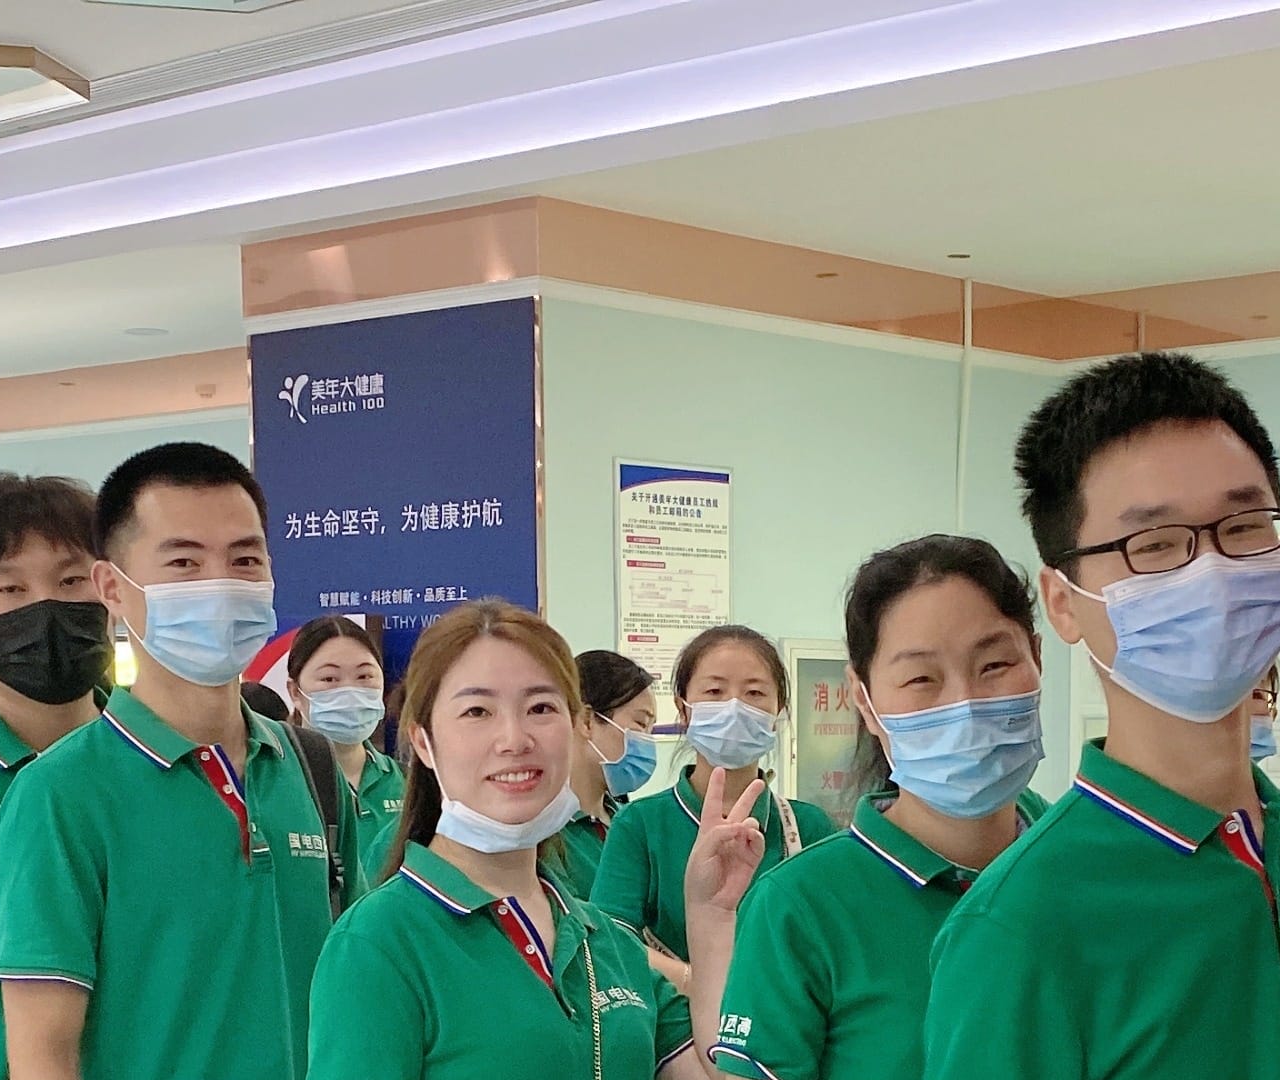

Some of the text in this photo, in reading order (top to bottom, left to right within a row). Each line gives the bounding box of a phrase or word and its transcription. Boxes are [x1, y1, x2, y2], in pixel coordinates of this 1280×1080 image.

[311, 373, 384, 400] 美年大健康
[311, 397, 385, 415] Health 100
[382, 615, 417, 630] LTHY
[288, 832, 326, 850] 国电西
[719, 1014, 752, 1037] 西高
